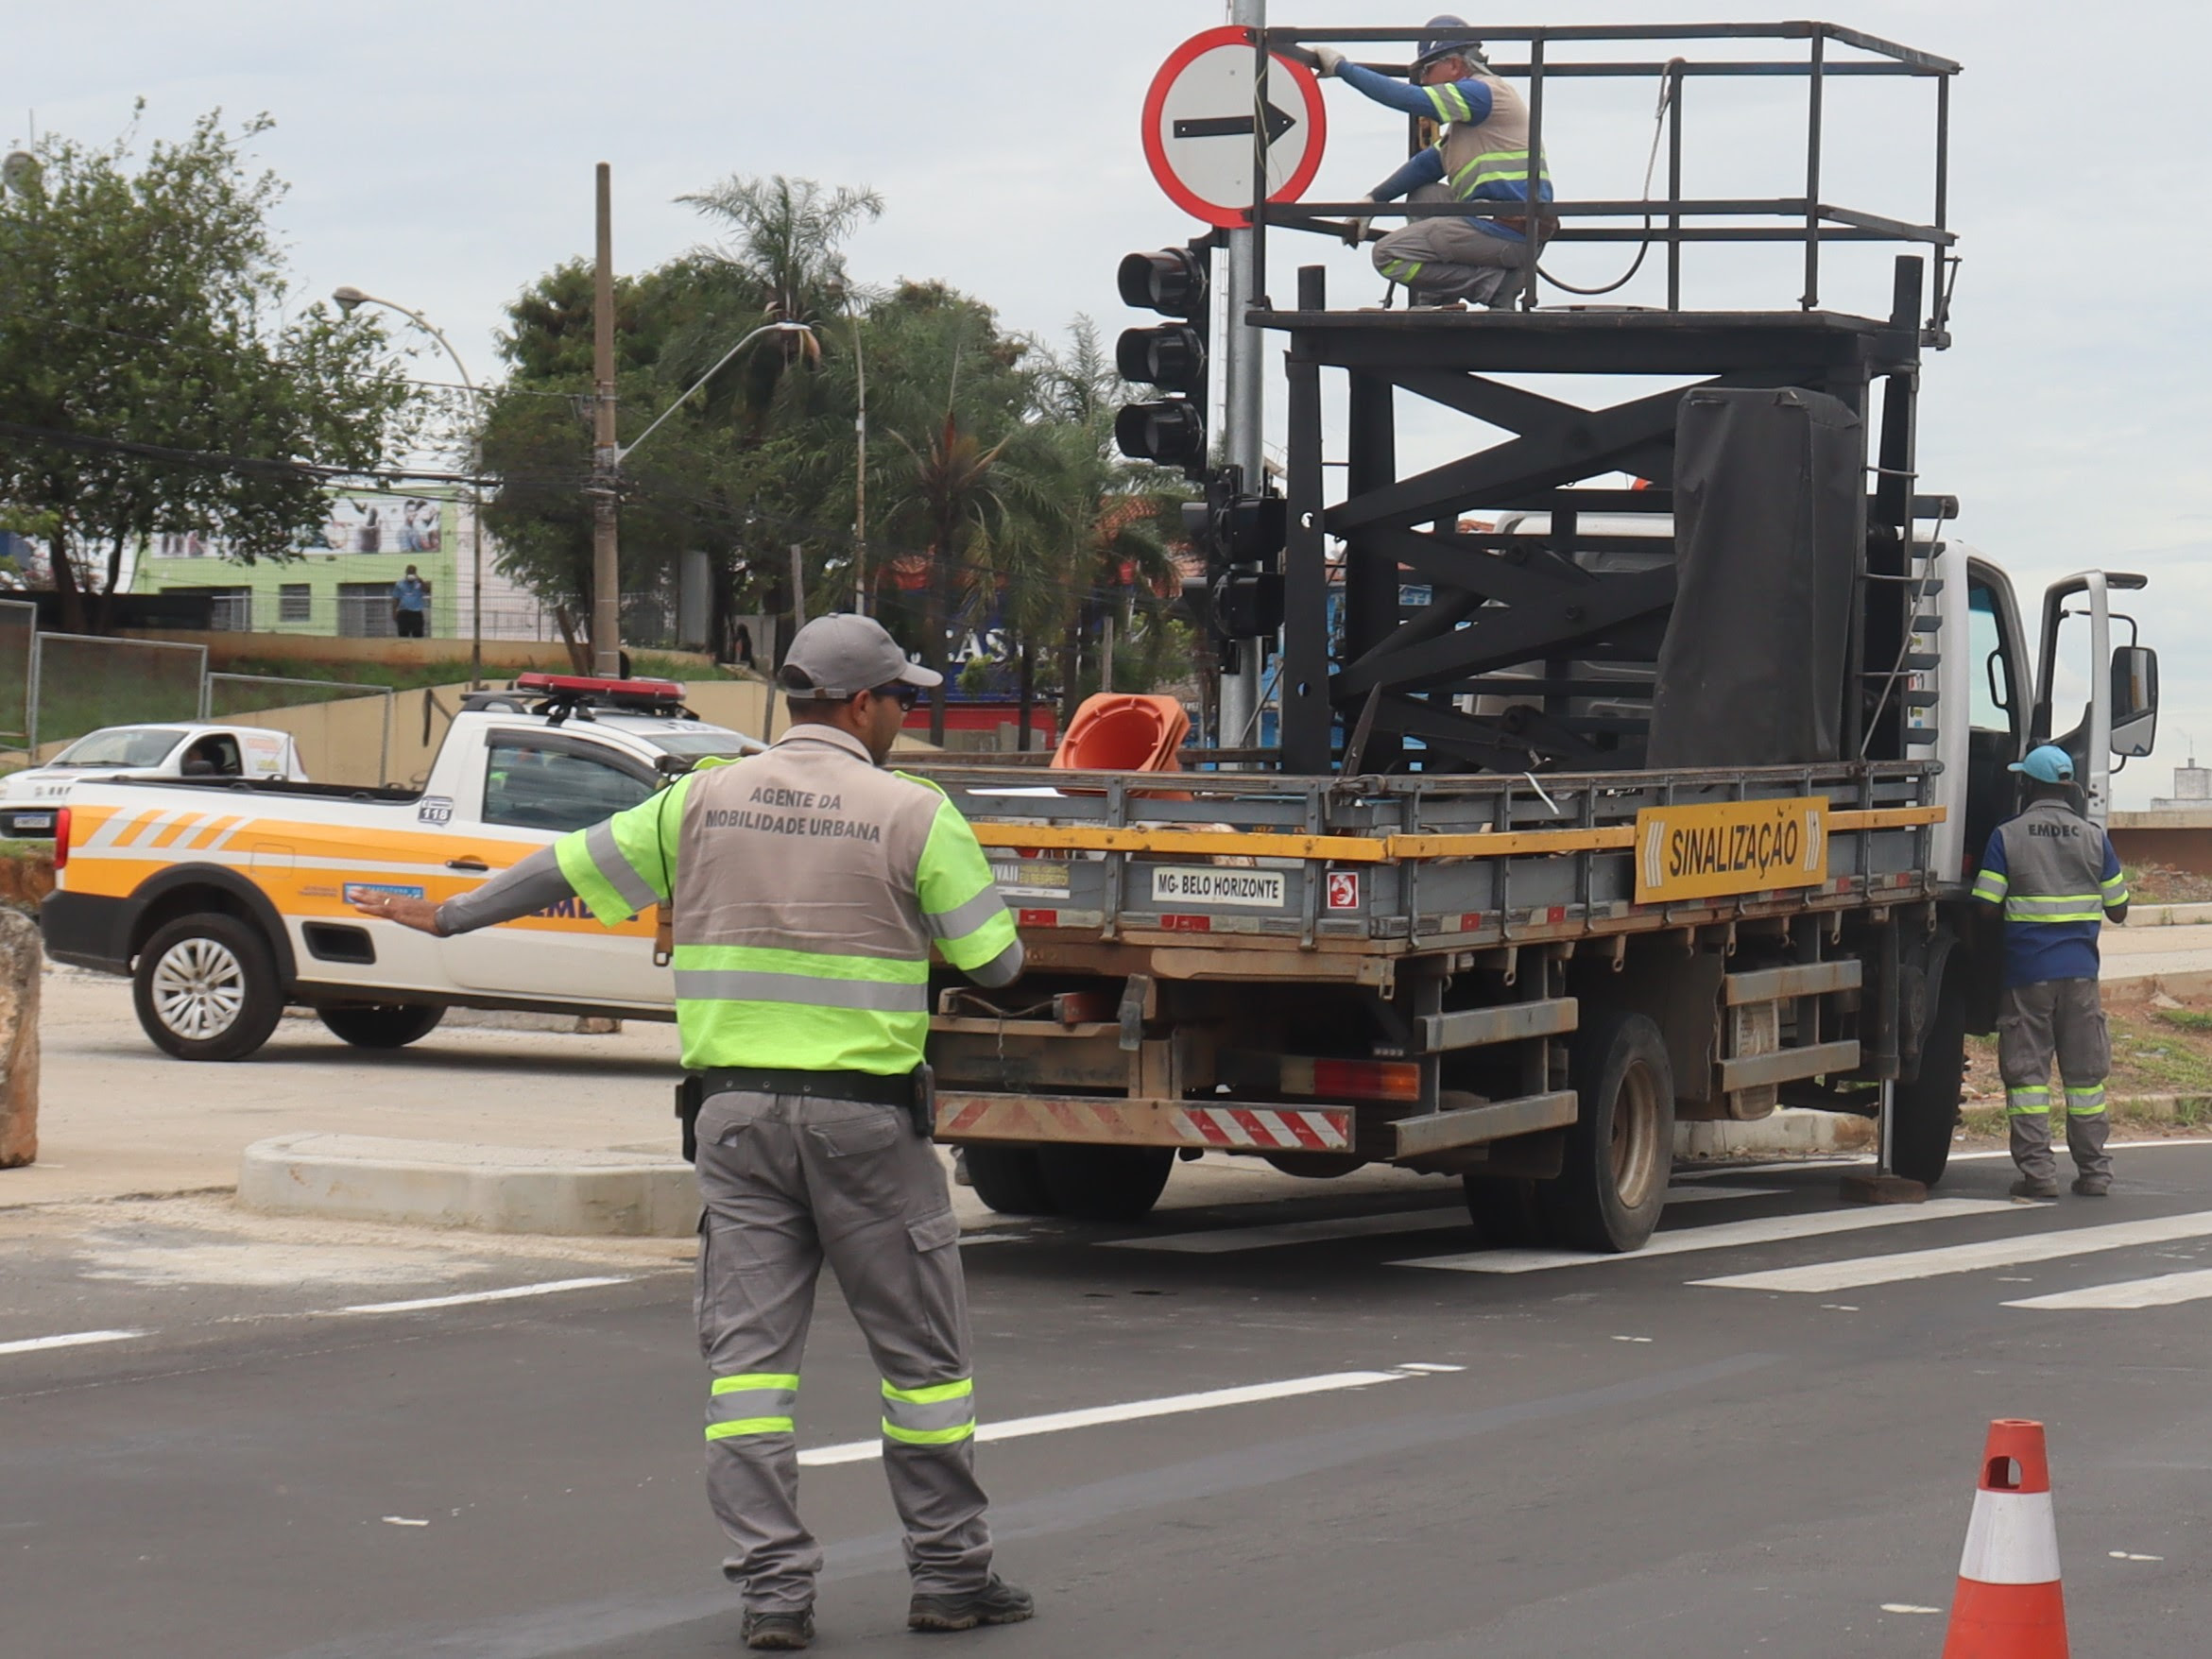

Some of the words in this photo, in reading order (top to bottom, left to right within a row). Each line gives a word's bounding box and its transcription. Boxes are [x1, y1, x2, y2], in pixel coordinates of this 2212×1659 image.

[749, 787, 815, 809] AGENTE
[817, 794, 841, 811] DA
[422, 808, 449, 820] 118
[705, 810, 807, 835] MOBILIDADE
[810, 818, 881, 843] URBANA
[2028, 824, 2080, 837] EMDEC
[1669, 807, 1798, 880] SINALIZAÇÃO
[1182, 876, 1211, 896] BELO
[1214, 878, 1278, 899] HORIZONTE
